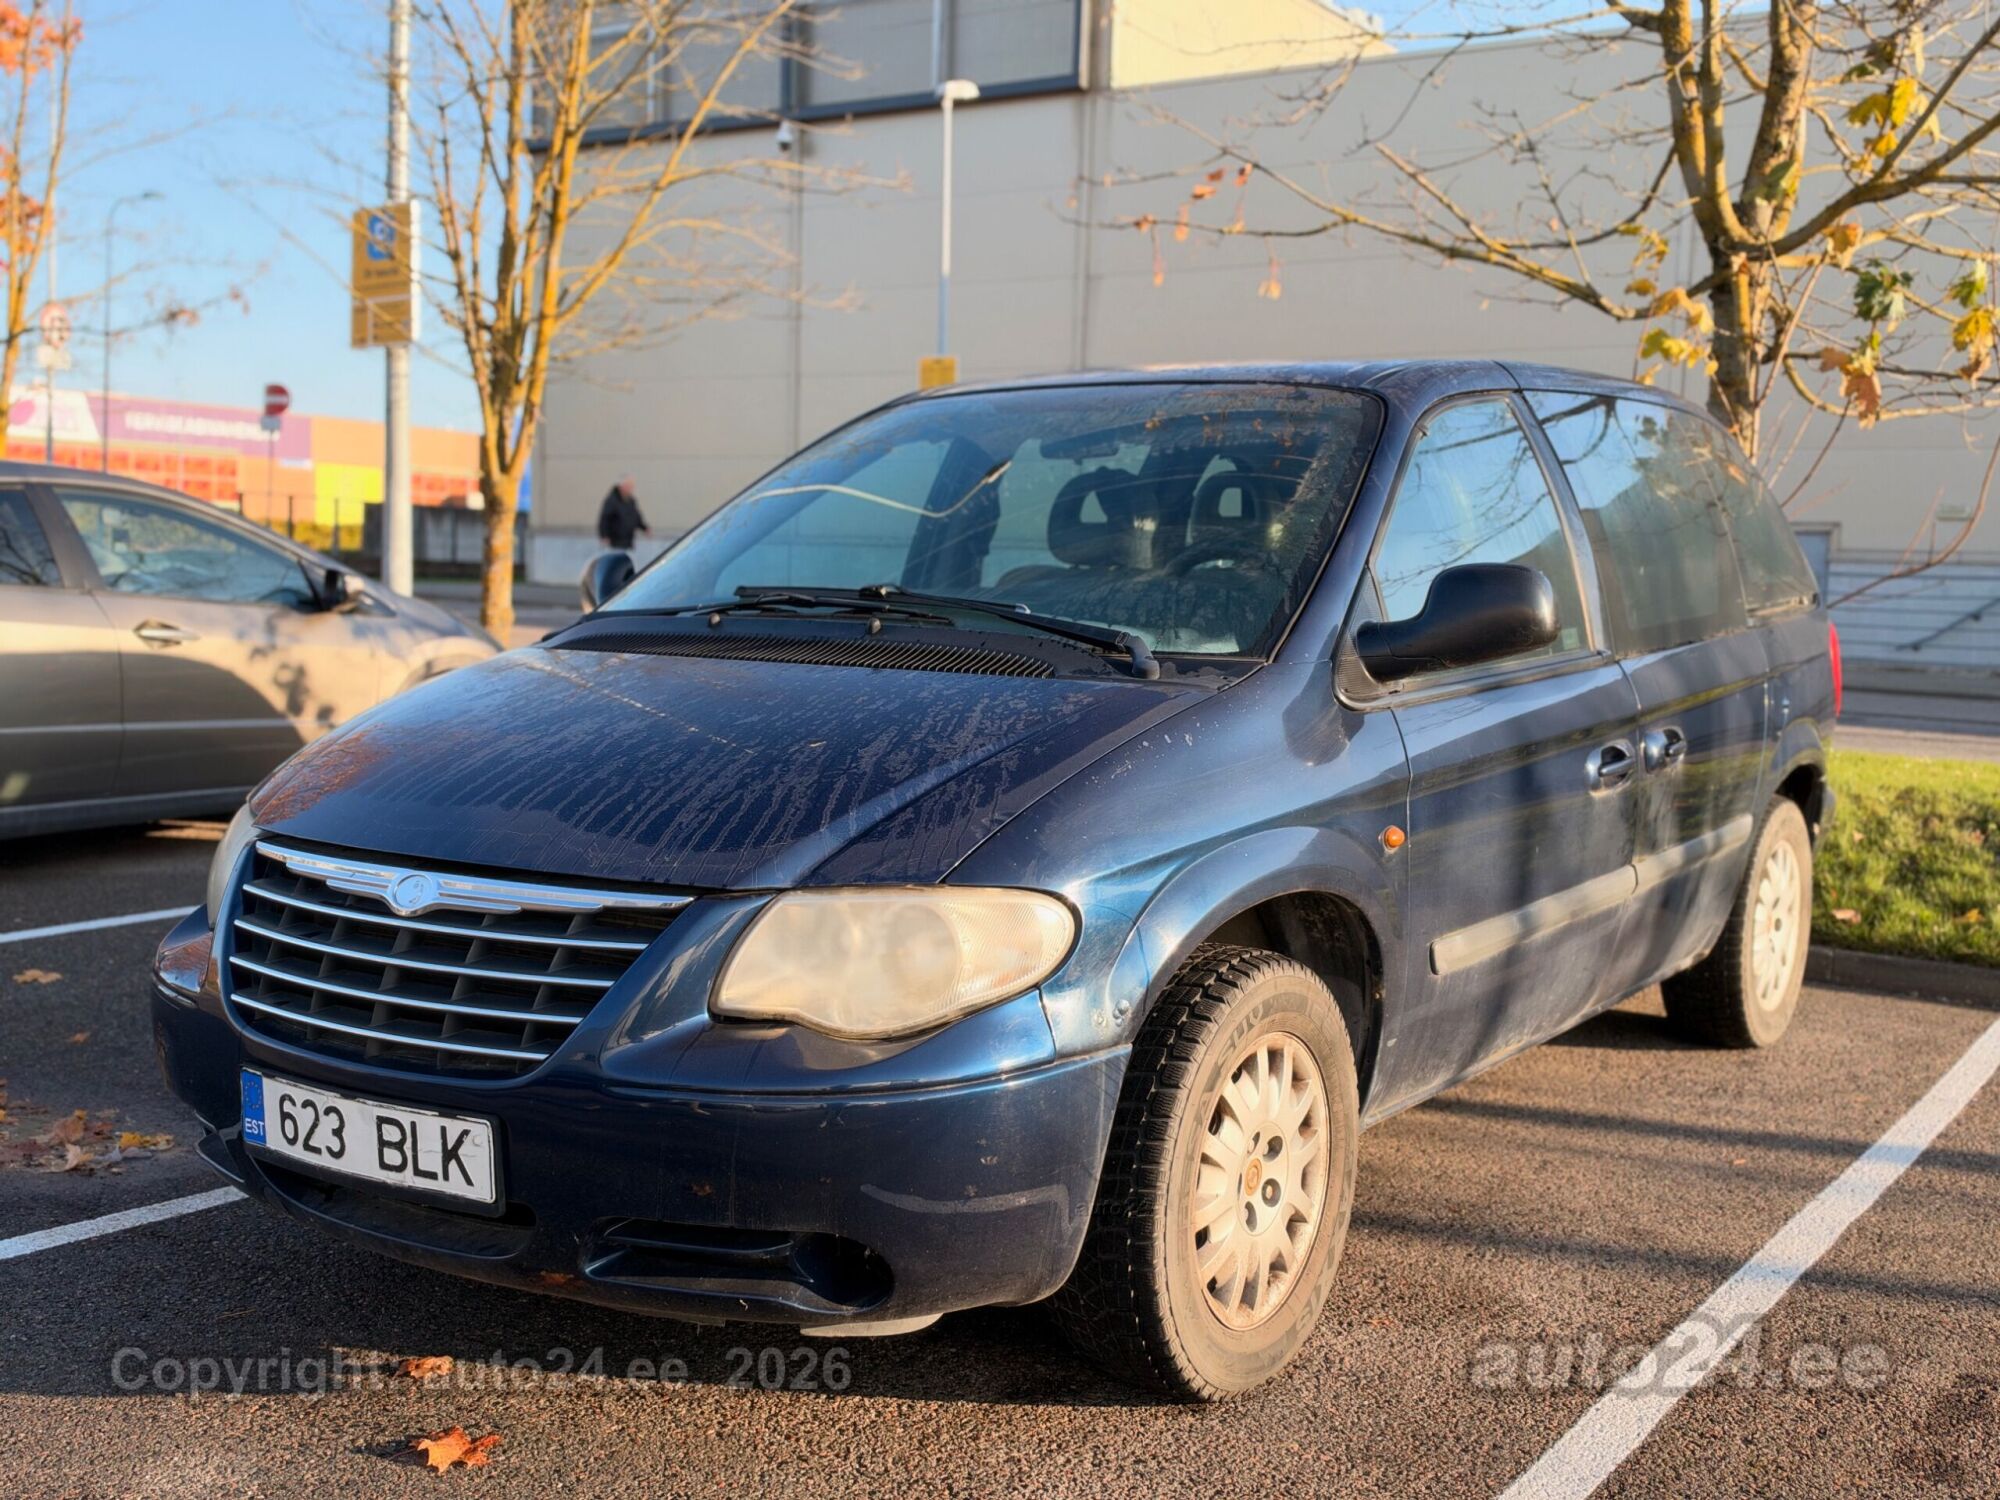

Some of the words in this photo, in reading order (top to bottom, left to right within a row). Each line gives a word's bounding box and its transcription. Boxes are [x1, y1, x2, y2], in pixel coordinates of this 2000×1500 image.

[245, 1117, 265, 1137] EST
[278, 1093, 347, 1160] 623
[376, 1114, 475, 1187] BLK
